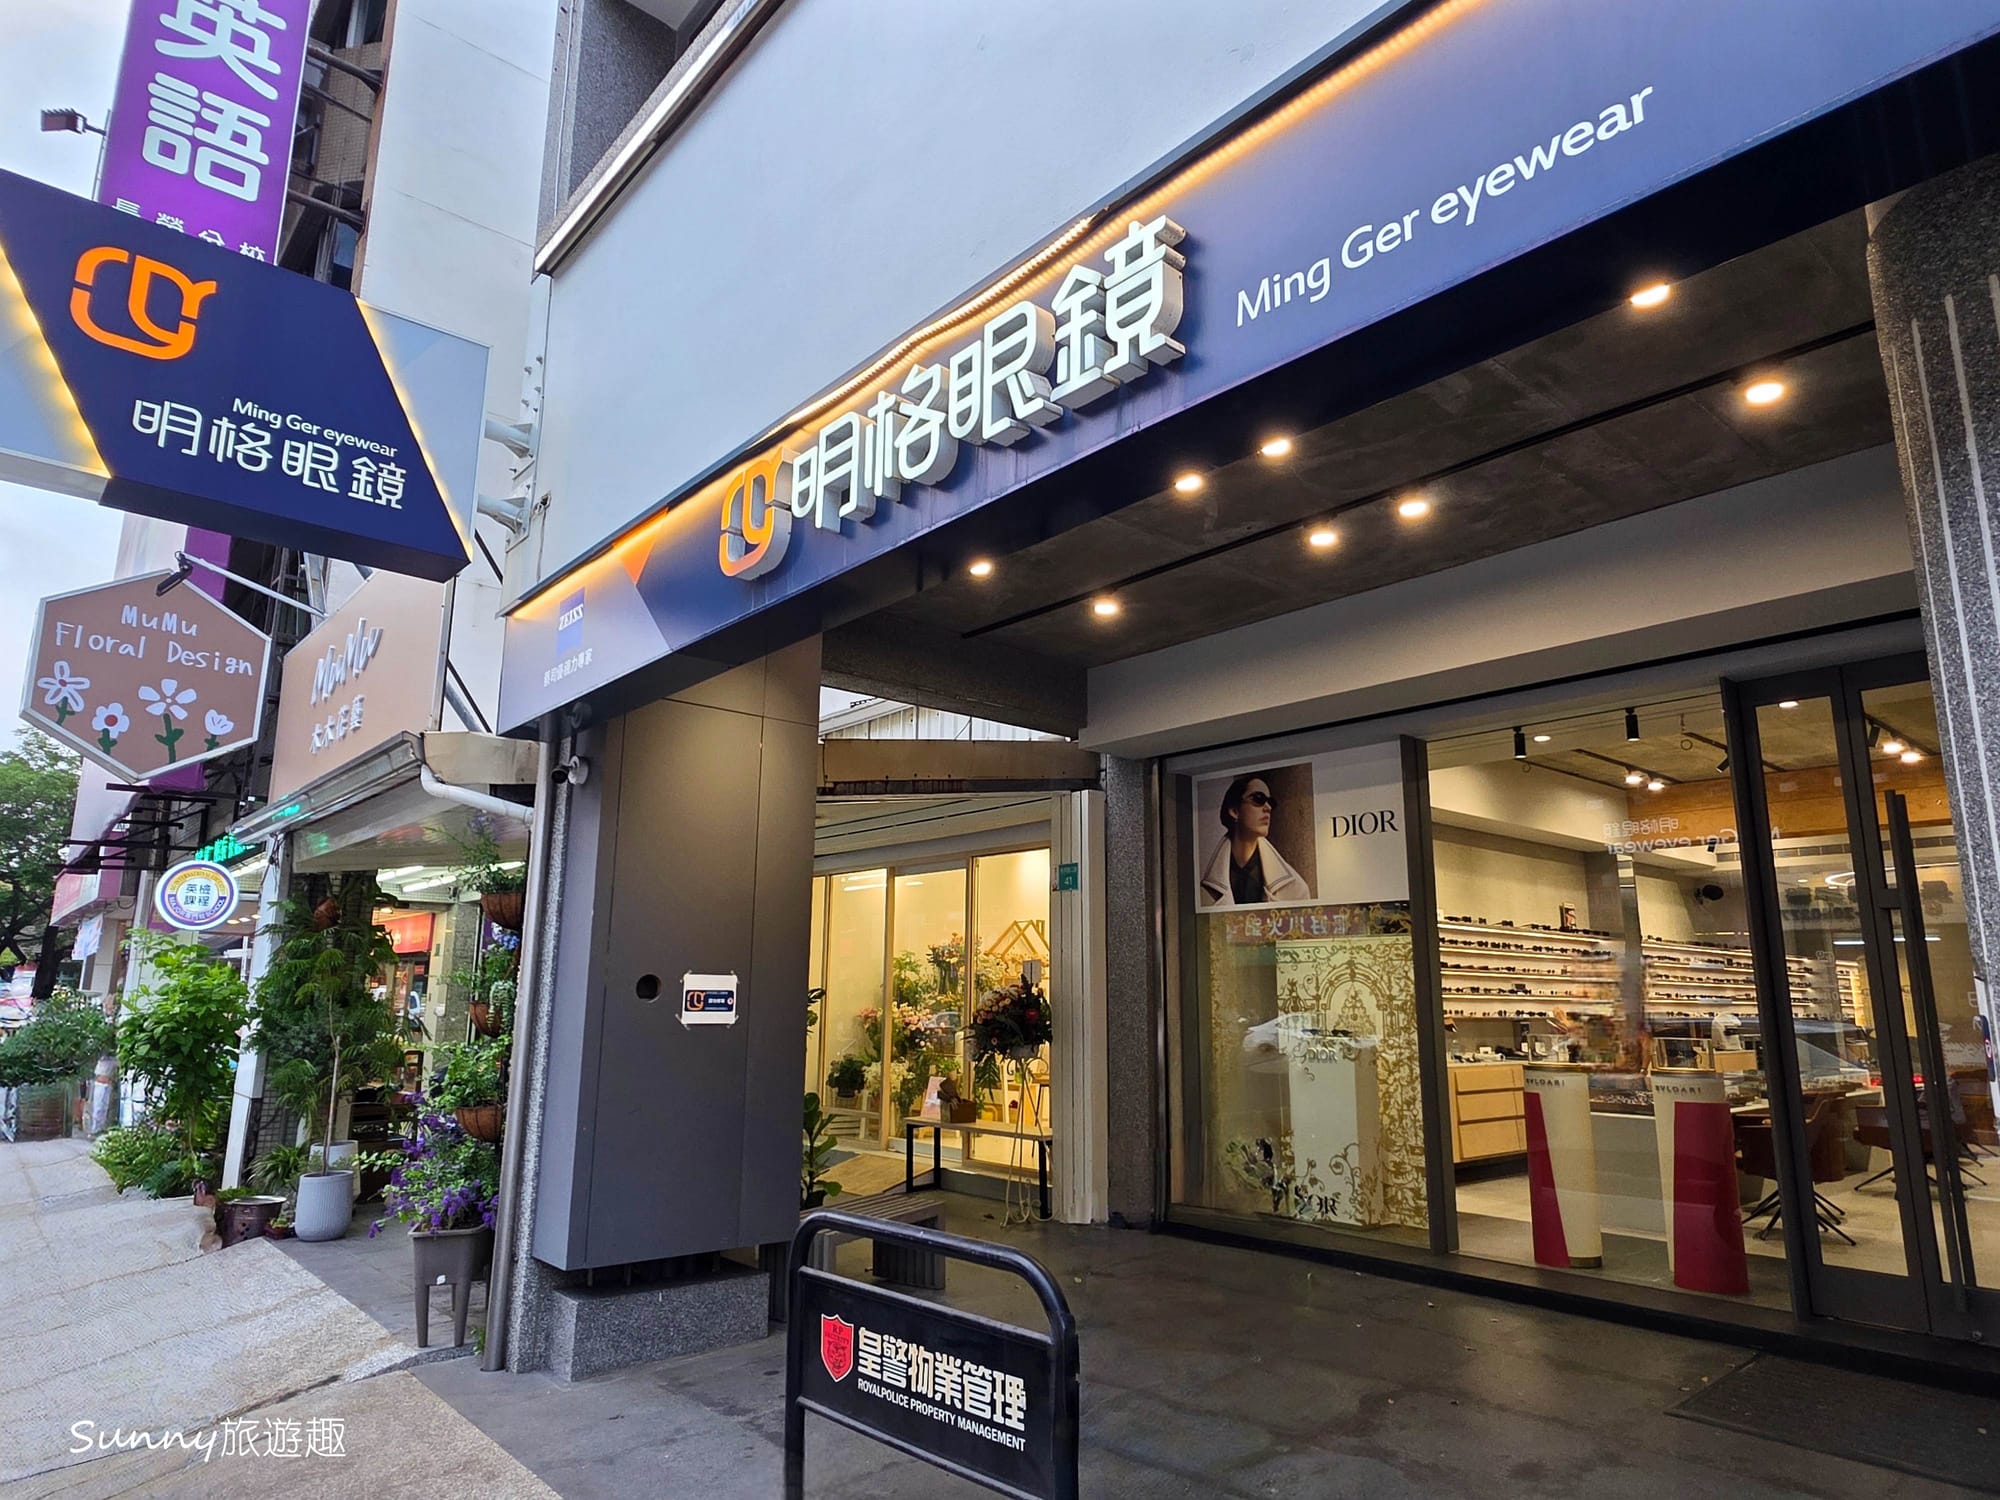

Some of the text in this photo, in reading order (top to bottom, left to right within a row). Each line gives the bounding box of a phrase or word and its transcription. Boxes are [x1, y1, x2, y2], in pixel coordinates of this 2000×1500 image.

[141, 0, 287, 202] 英語
[1236, 86, 1654, 327] Ming Ger eyewear
[791, 215, 1186, 533] 明格眼鏡
[131, 399, 407, 509] 明格眼鏡
[233, 397, 398, 458] Ming Ger eyewear
[55, 621, 254, 677] Floral Design
[120, 604, 198, 637] MuMu
[558, 603, 584, 631] ZEISS
[310, 617, 384, 706] MuMu
[1331, 810, 1399, 838] DIOR
[857, 1326, 1027, 1431] 皇警物業管理
[857, 1378, 1026, 1452] ROYALPOLICE PROPERTY MANAGEMENT
